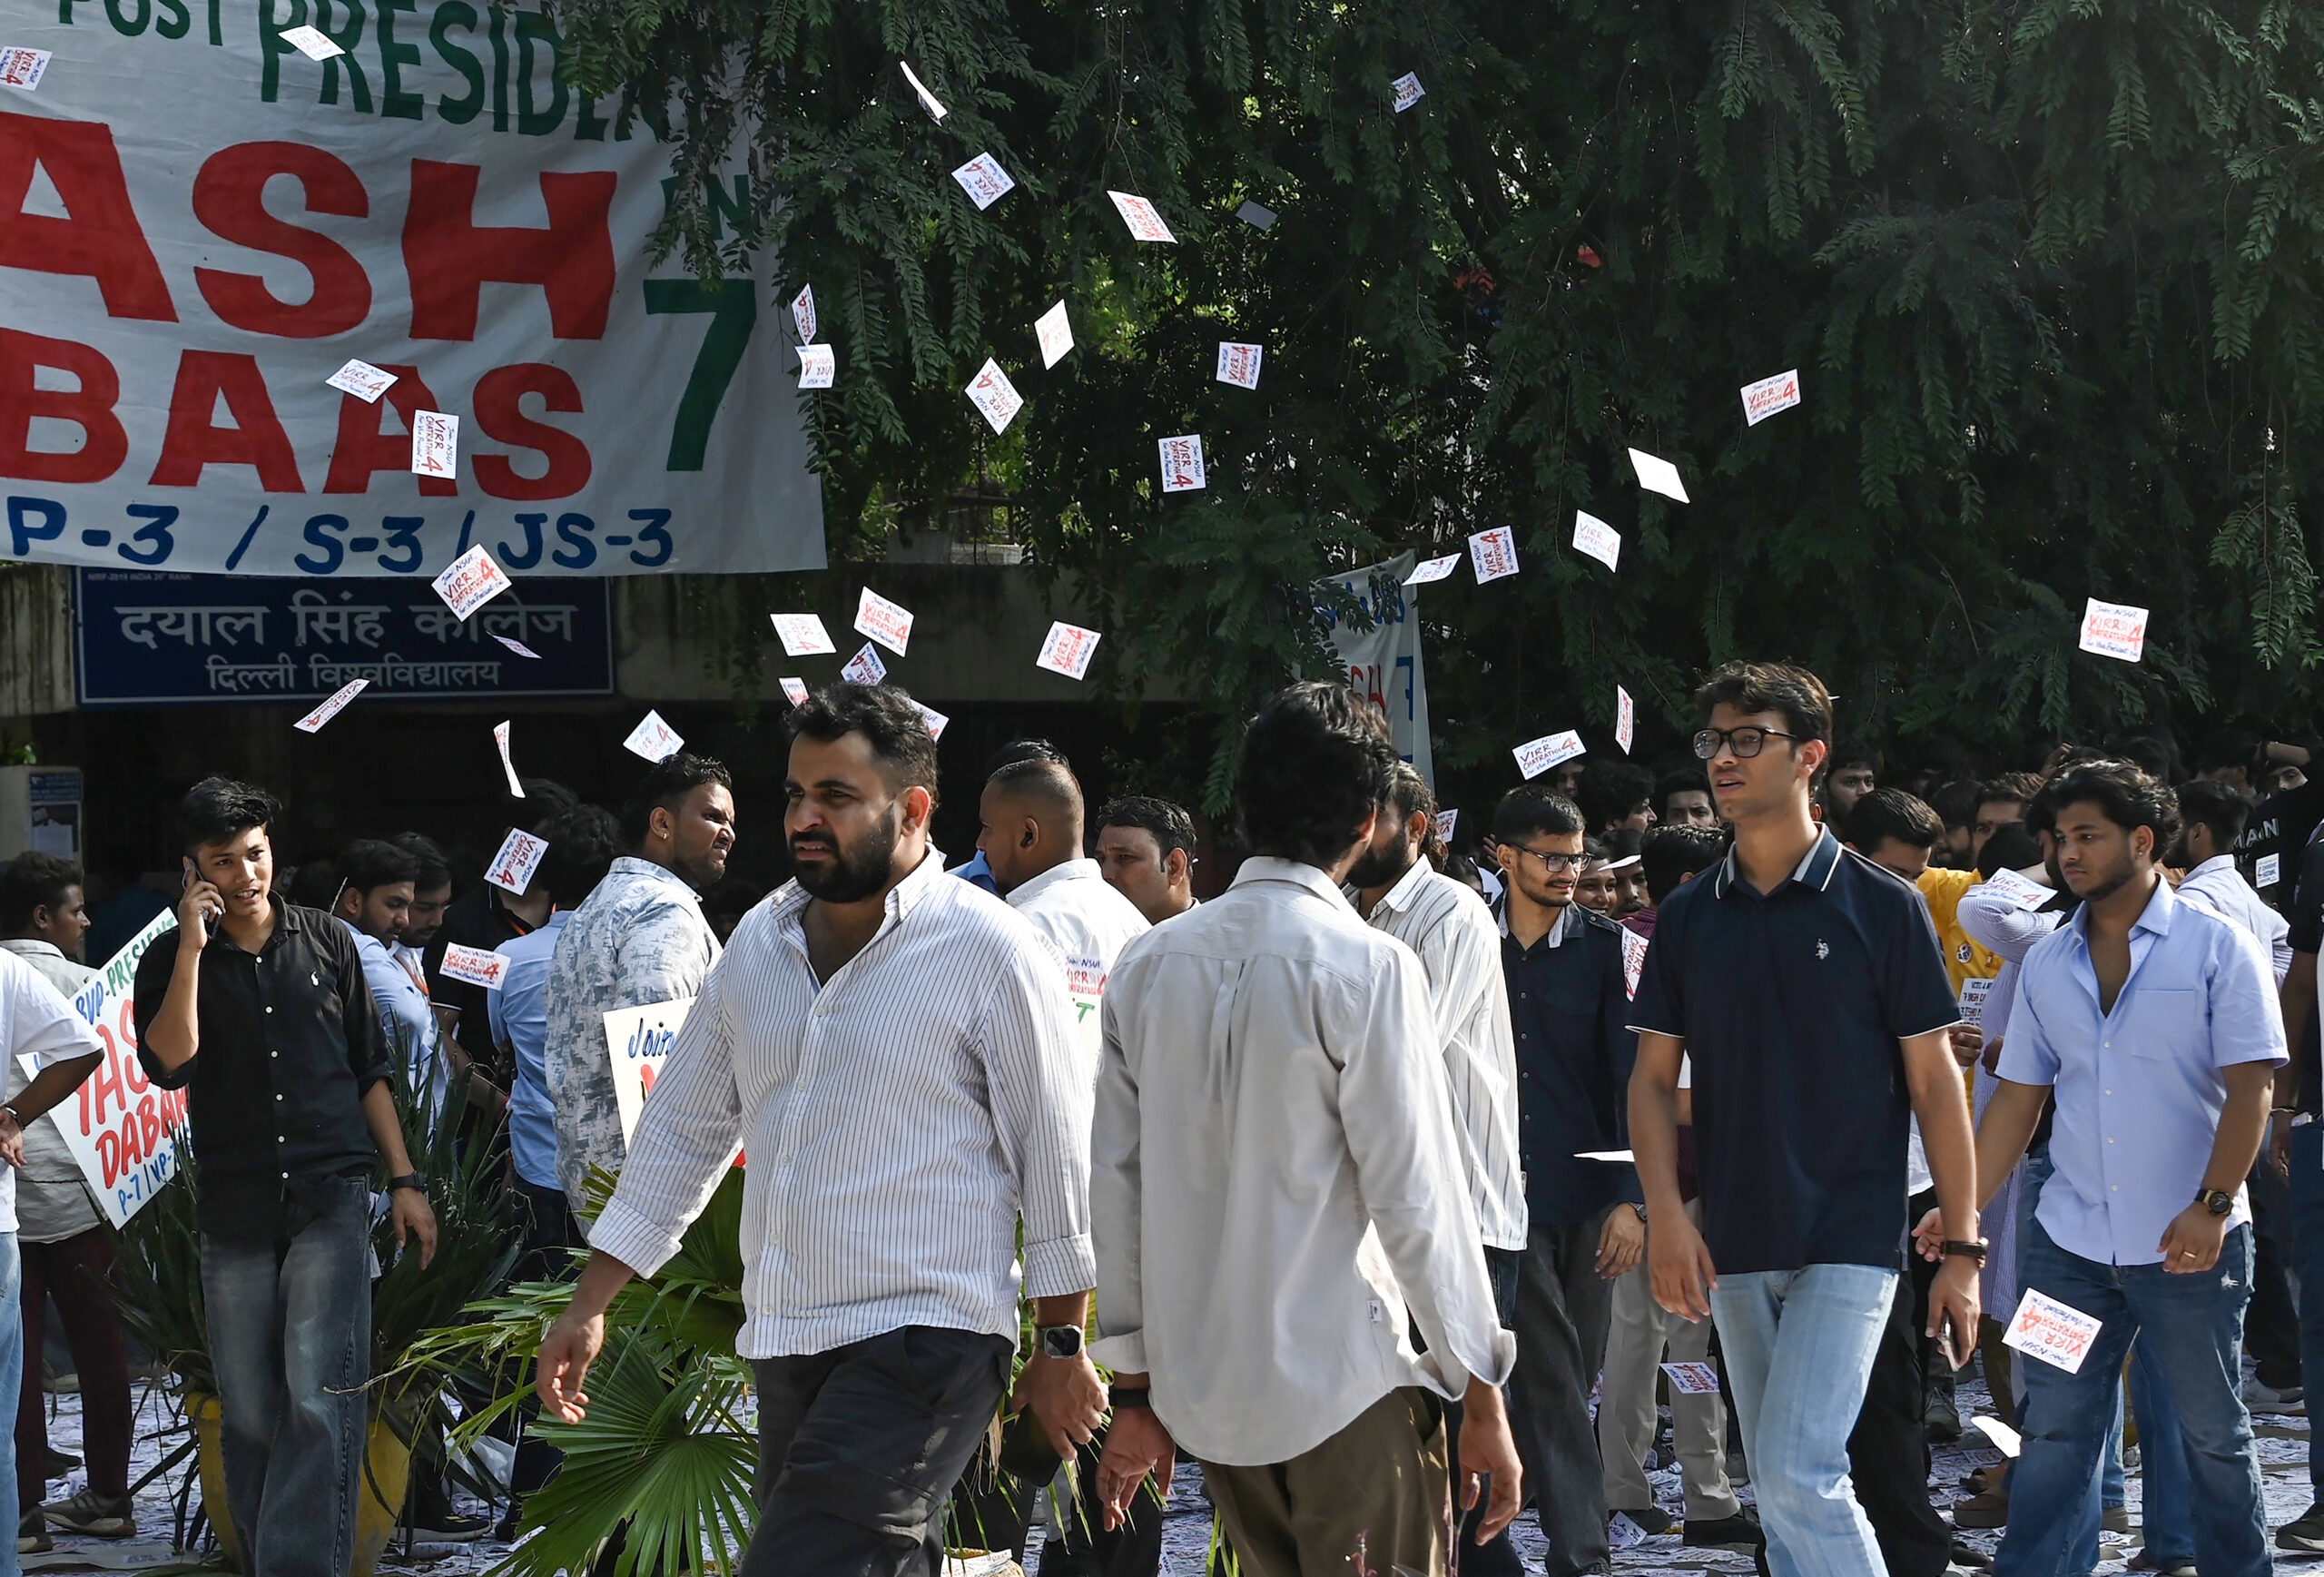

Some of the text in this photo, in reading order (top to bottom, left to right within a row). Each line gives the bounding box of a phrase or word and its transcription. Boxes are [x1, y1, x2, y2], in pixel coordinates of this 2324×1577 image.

[643, 278, 756, 471] 7
[435, 419, 445, 448] VIRR
[421, 456, 443, 471] 4
[1177, 440, 1191, 467] VIRR
[1171, 474, 1193, 487] 4
[497, 508, 673, 570] JS-3
[480, 559, 497, 581] 4
[114, 606, 271, 649] दयाल
[290, 589, 391, 648] सिंह
[205, 653, 297, 691] दिल्ली
[517, 841, 536, 866] VIRR
[496, 869, 515, 885] 4
[2019, 1306, 2045, 1332] 4
[2044, 1328, 2083, 1355] VIRR
